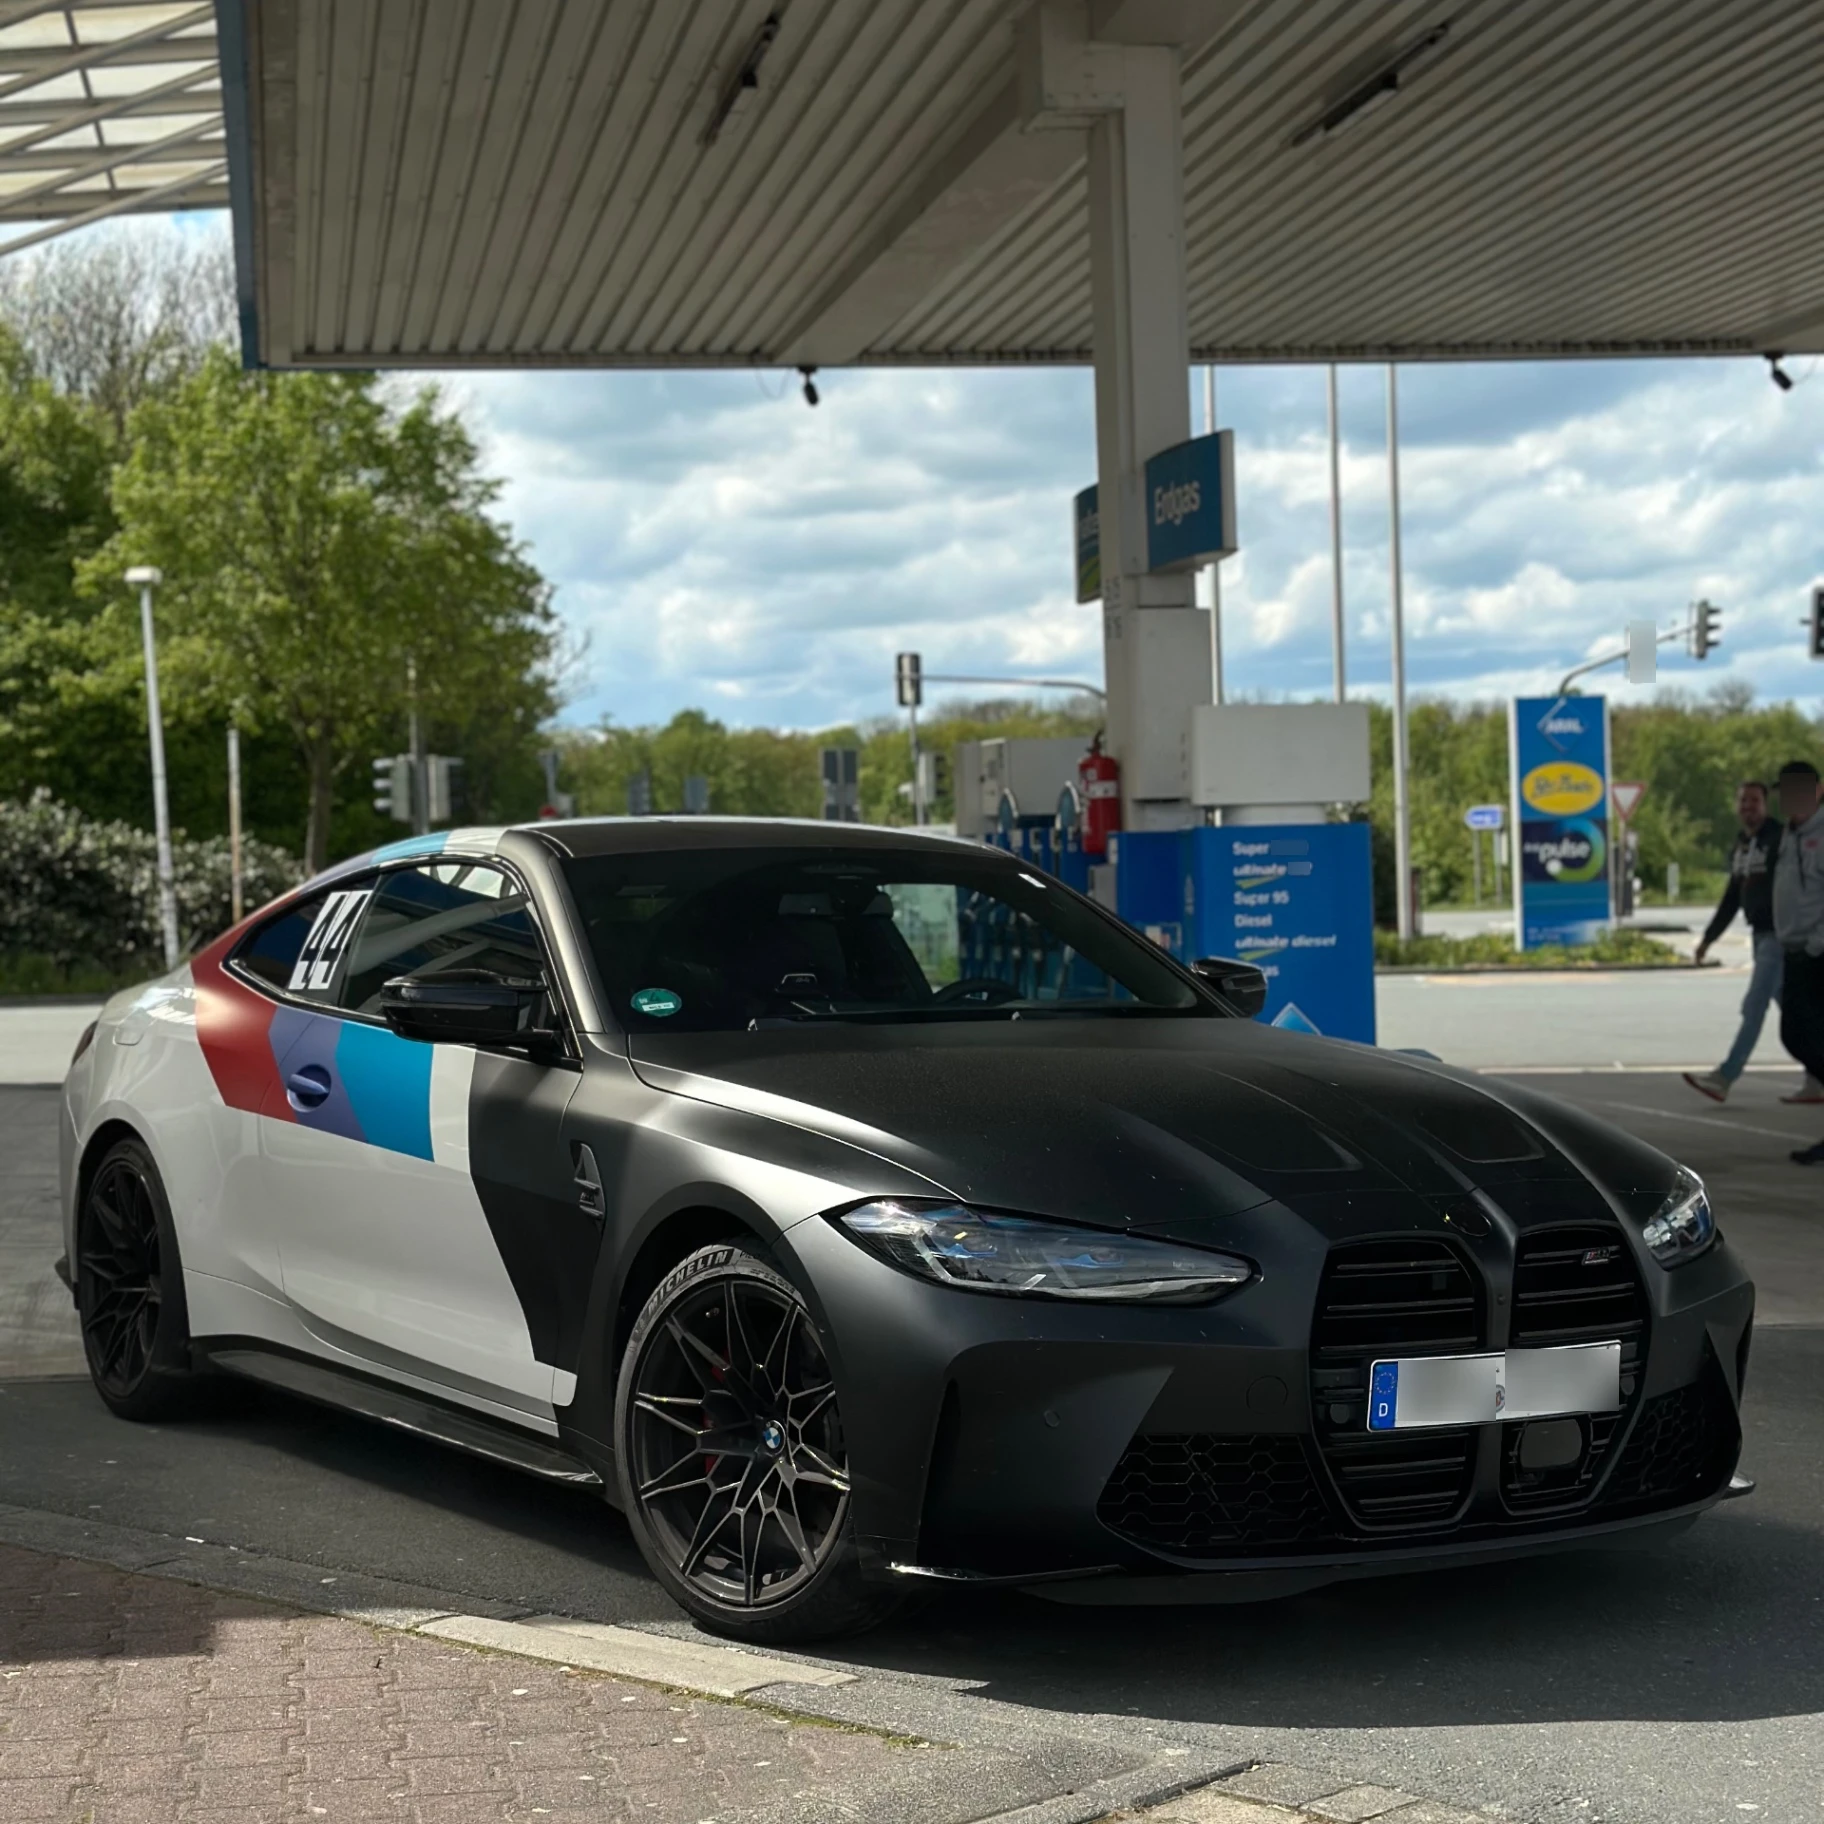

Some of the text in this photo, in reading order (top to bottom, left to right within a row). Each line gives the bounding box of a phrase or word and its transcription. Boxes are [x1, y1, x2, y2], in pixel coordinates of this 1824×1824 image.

[1232, 841, 1270, 857] Super
[1538, 837, 1590, 863] pulse
[1233, 863, 1287, 876] ultimate
[1234, 890, 1290, 906] Super 95
[1234, 914, 1273, 927] Diesel
[288, 890, 373, 989] 44
[1235, 934, 1337, 949] ultimate diesel
[648, 1250, 729, 1316] MICHELIN
[1378, 1403, 1389, 1418] D
